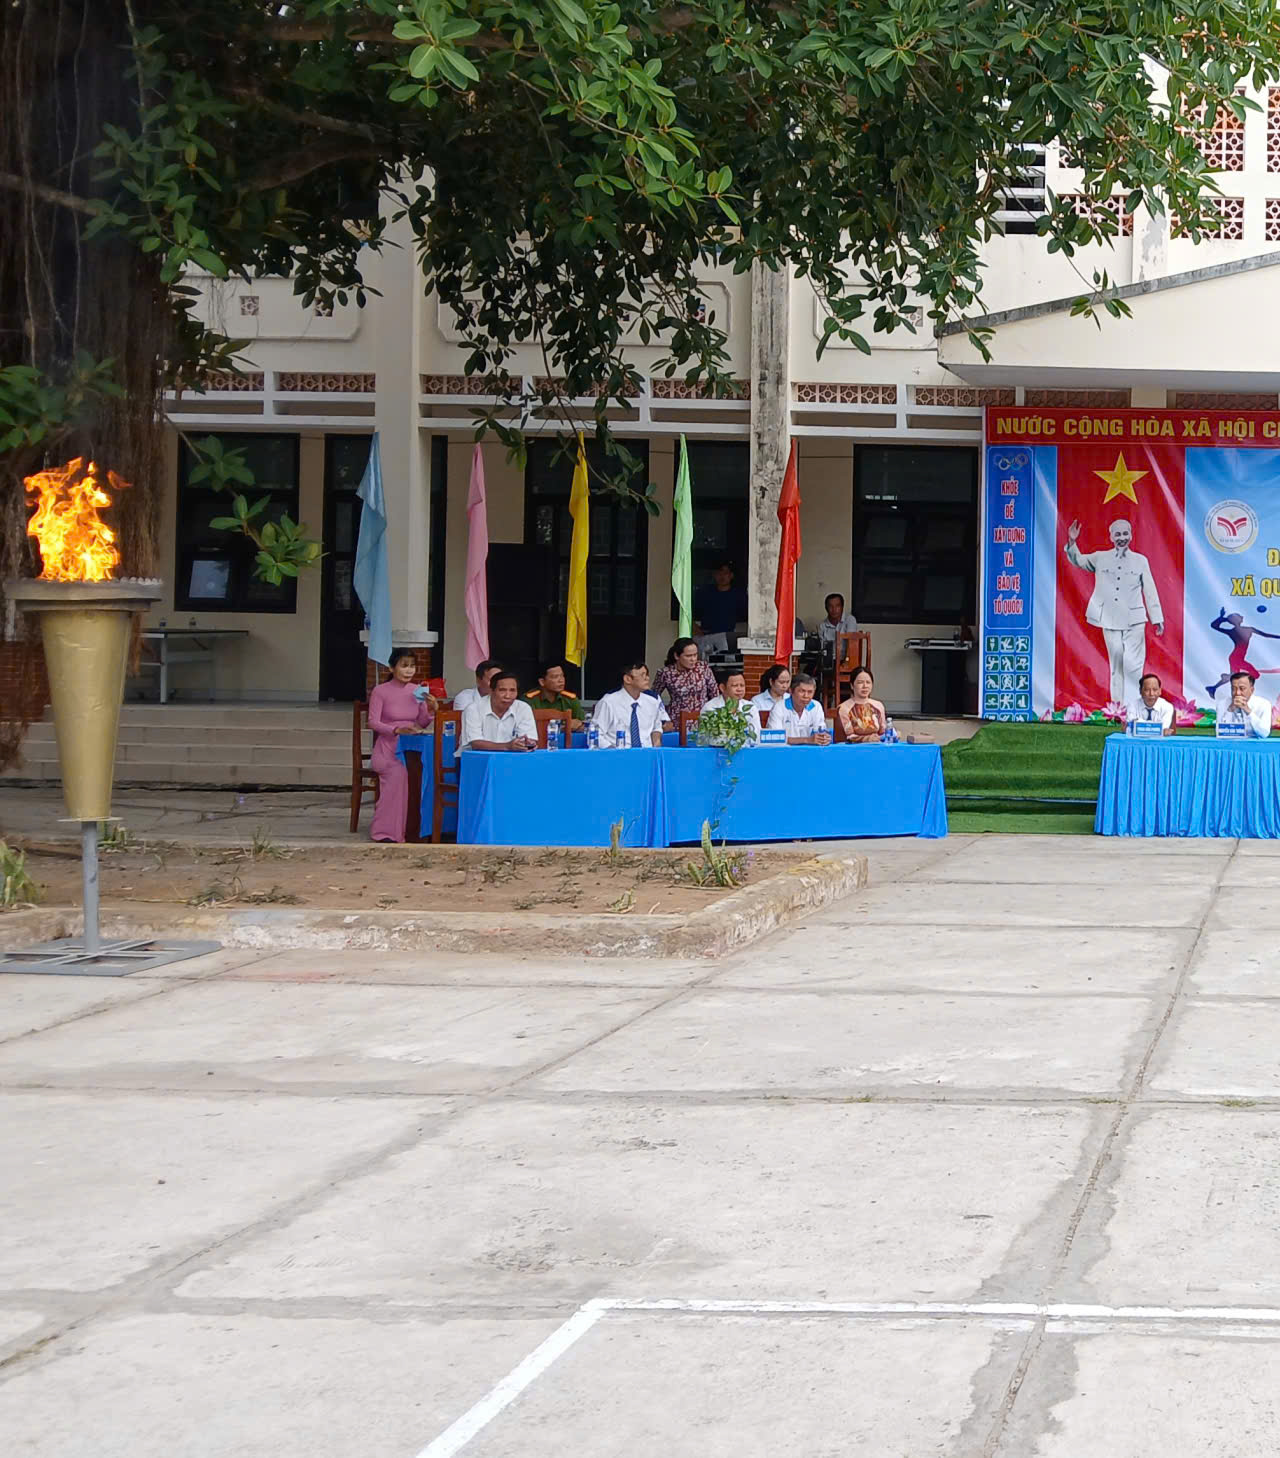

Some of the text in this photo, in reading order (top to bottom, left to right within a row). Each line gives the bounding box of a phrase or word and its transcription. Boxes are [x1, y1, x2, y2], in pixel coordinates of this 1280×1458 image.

[996, 415, 1056, 435] NƯỚC
[1063, 416, 1123, 439] CỘNG
[1130, 416, 1175, 437] HÒA
[1182, 417, 1212, 437] XÃ
[1218, 417, 1254, 440] HỘI
[1231, 575, 1255, 596] XÃ
